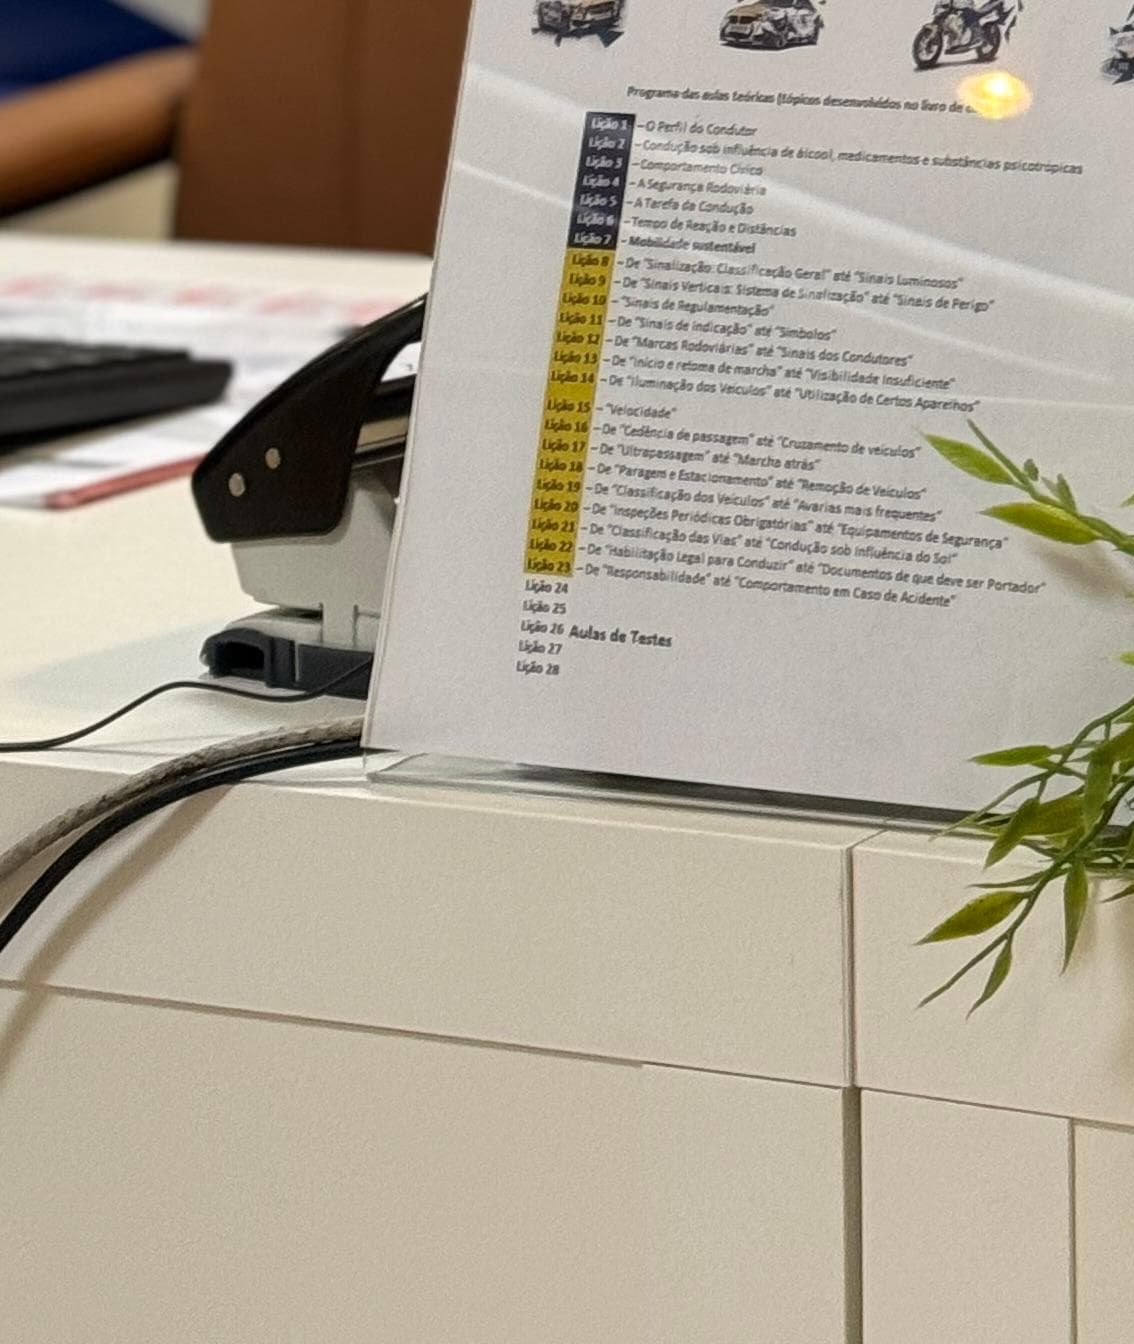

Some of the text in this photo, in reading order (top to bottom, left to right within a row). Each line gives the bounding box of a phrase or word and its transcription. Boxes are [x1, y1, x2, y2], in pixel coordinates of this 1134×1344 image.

[590, 116, 619, 133] Lição
[619, 119, 628, 131] 1
[588, 135, 617, 150] Lição
[617, 137, 626, 149] 2
[780, 145, 794, 158] de
[584, 154, 614, 169] Lição
[613, 156, 623, 169] 3
[581, 173, 611, 188] Lição
[611, 176, 620, 187] 4
[578, 193, 608, 209] Lição
[608, 195, 618, 207] 5
[576, 211, 606, 226] Lição
[605, 214, 615, 226] 6
[669, 216, 684, 230] de
[573, 231, 602, 246] Lição
[602, 233, 612, 245] 7
[571, 252, 610, 267] Lição 8
[568, 272, 606, 287] Lição 9
[561, 291, 590, 306] Lição
[591, 294, 607, 306] 10
[660, 298, 675, 311] de
[558, 311, 603, 326] Lição 11
[555, 330, 600, 345] Lição 12
[552, 349, 598, 365] Lição 13
[550, 369, 594, 384] Lição 14
[546, 397, 575, 413] Lição
[576, 400, 591, 413] 15
[543, 417, 572, 433] Lição
[573, 420, 588, 433] 16
[601, 422, 617, 435] De
[675, 427, 690, 441] de
[850, 441, 865, 455] de
[541, 437, 569, 453] Lição
[571, 440, 586, 453] 17
[598, 442, 614, 455] De
[538, 457, 583, 473] Lição 18
[535, 477, 564, 492] Lição
[566, 480, 581, 493] 19
[593, 482, 609, 495] De
[530, 517, 559, 533] Lição
[560, 519, 576, 535] 21
[588, 522, 604, 535] De
[533, 497, 562, 512] Lição
[562, 499, 579, 513] 20
[591, 502, 607, 515] De
[924, 529, 940, 543] de
[528, 537, 573, 553] Lição 22
[524, 578, 568, 594] Lição 24
[526, 556, 554, 572] Lição
[556, 560, 571, 573] 23
[584, 562, 600, 576] De
[882, 588, 898, 602] de
[522, 599, 566, 615] Lição 25
[520, 619, 672, 647] Lição 26 Aulas de Testes
[518, 639, 563, 655] Lição 27
[515, 659, 560, 675] Lição 28
